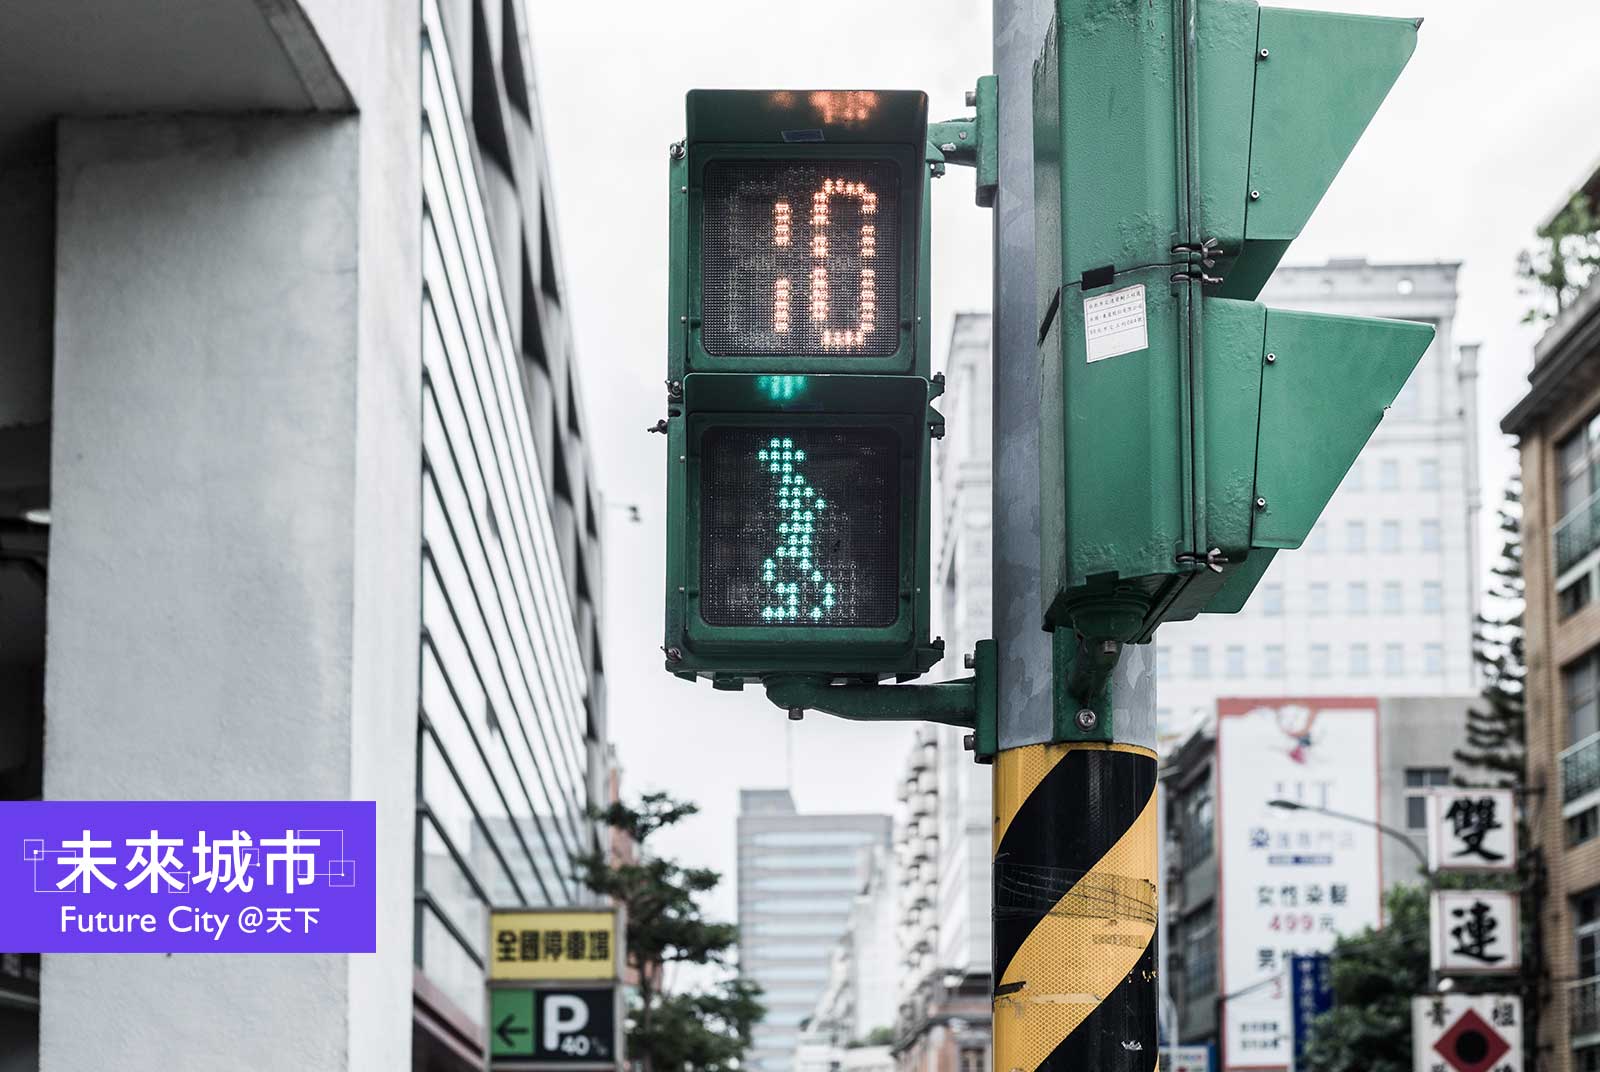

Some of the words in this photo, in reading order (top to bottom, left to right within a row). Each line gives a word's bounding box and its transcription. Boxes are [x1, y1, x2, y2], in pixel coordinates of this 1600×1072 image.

[772, 178, 879, 351] 10
[497, 930, 609, 962] 全國停車場
[543, 994, 589, 1051] P
